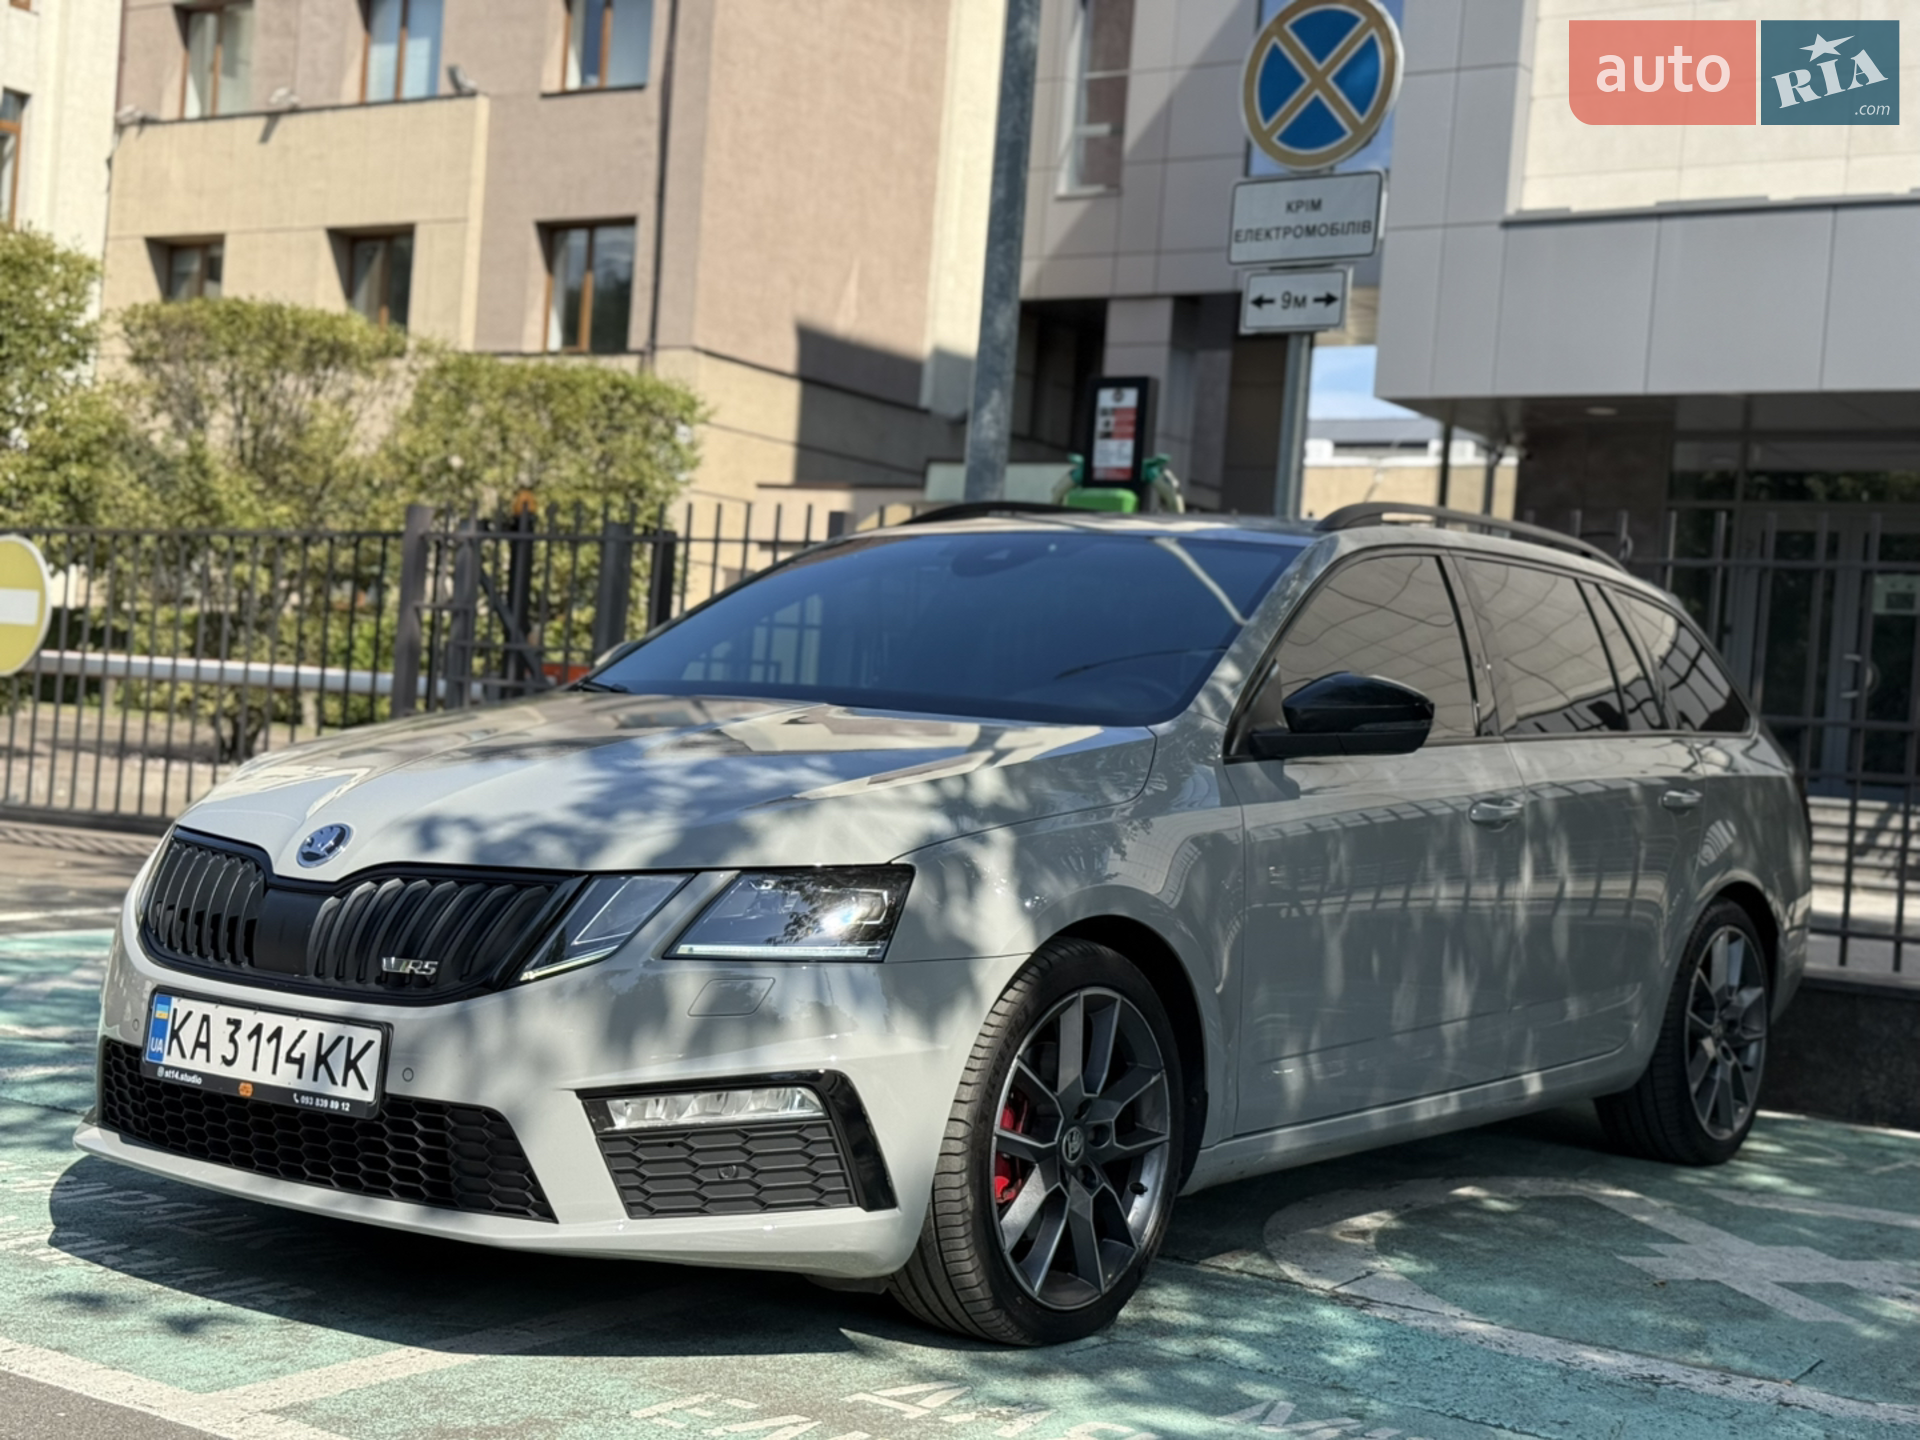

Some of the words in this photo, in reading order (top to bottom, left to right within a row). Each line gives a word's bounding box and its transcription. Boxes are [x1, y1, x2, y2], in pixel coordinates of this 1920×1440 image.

[1285, 199, 1322, 213] КРІМ
[1234, 220, 1372, 243] ЕЛЕКТРОМОБІЛІВ
[150, 1037, 164, 1054] UA
[341, 1101, 350, 1112] 12
